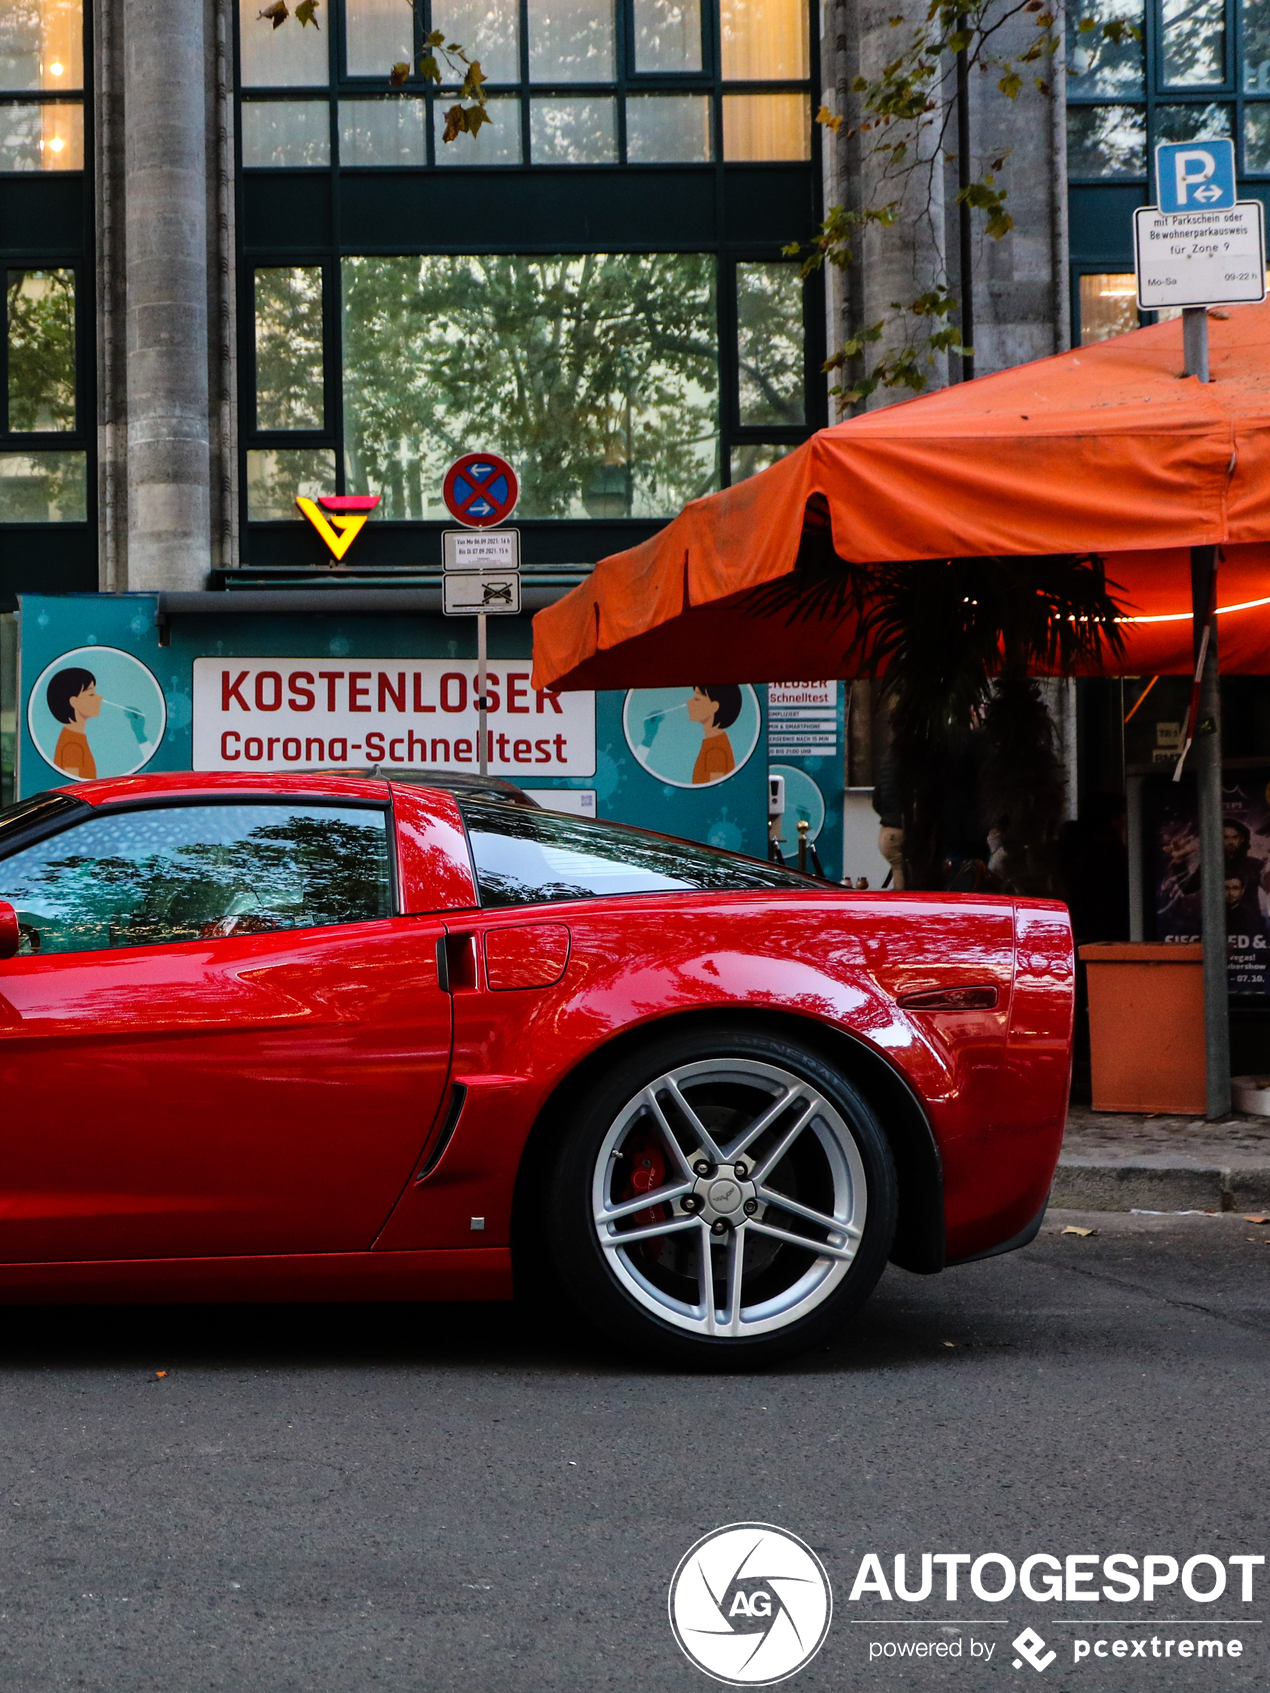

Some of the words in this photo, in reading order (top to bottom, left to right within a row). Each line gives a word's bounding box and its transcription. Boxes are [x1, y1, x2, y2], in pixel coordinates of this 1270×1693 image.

[1154, 217, 1169, 227] mit
[1172, 214, 1220, 226] Parkschein
[1224, 212, 1243, 222] oder
[1150, 225, 1248, 240] Bewohnerparkausweis
[1170, 244, 1186, 255] für
[1192, 243, 1219, 254] Zone
[1224, 242, 1230, 251] 9
[1147, 277, 1178, 287] Mo-Sa
[1224, 273, 1250, 282] 09-22
[1251, 272, 1258, 280] h
[221, 669, 565, 715] KOSTENLOSER
[770, 693, 829, 703] Schnelltest
[220, 729, 568, 764] Corona-Schnelltest
